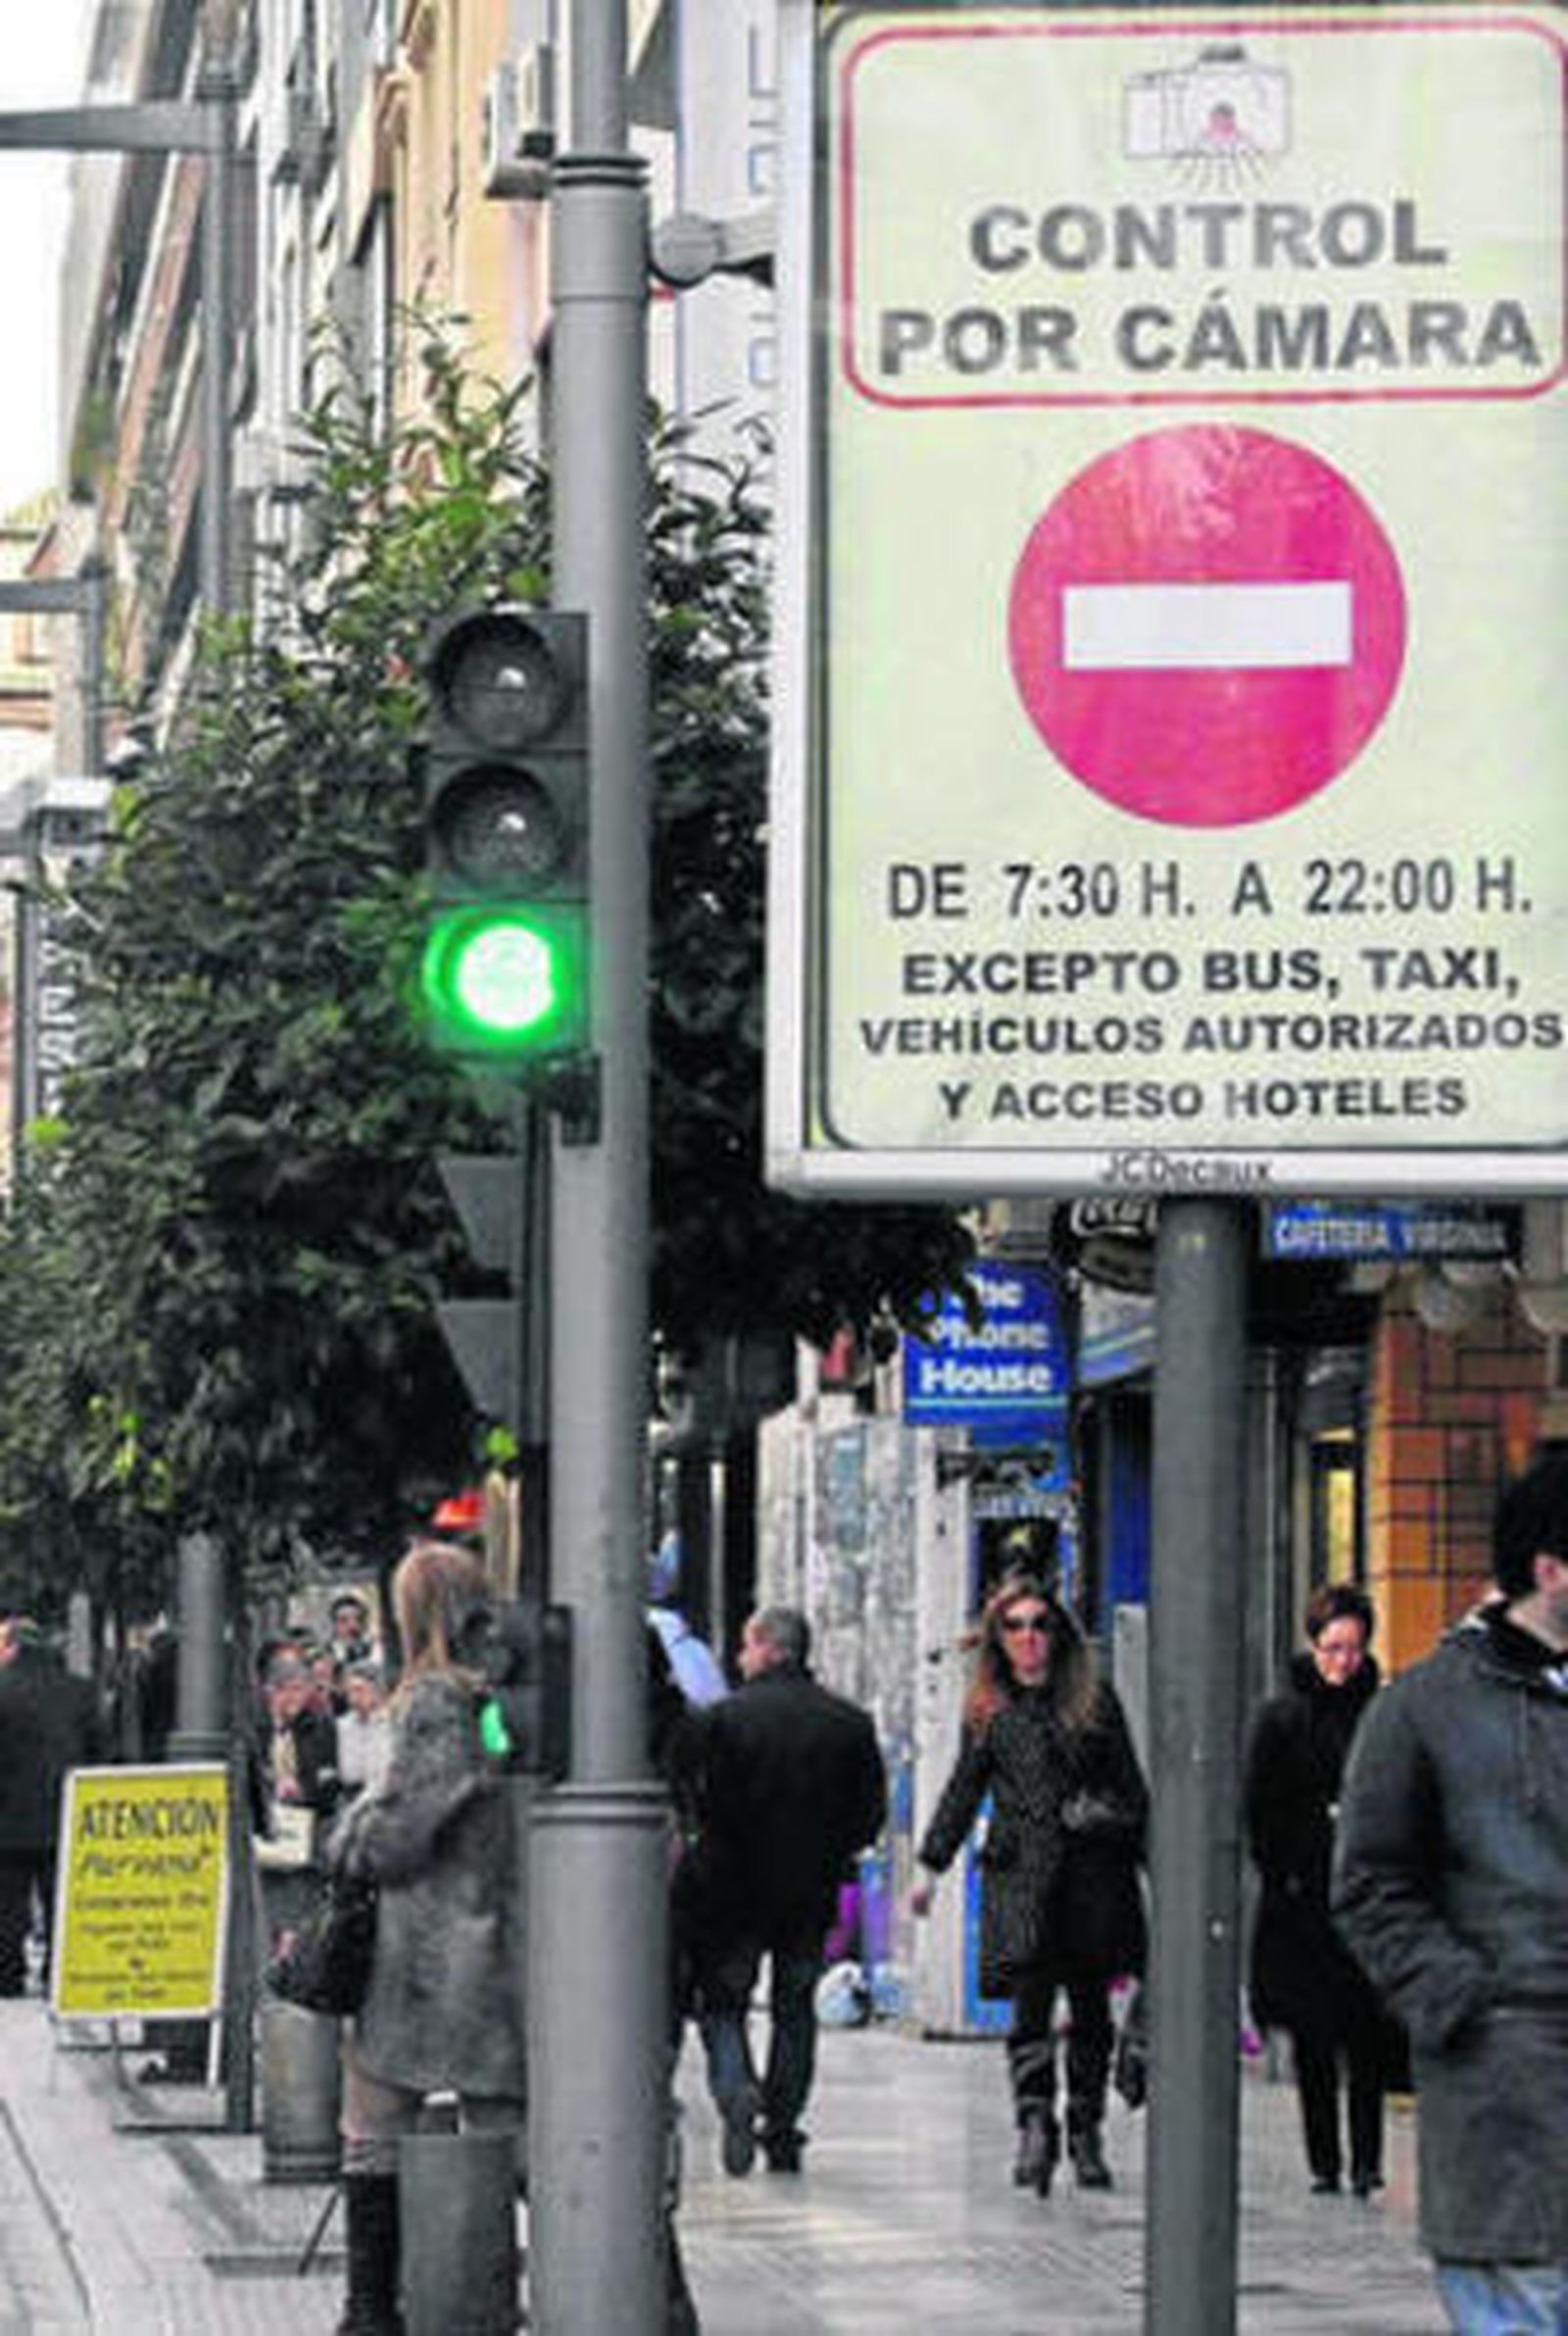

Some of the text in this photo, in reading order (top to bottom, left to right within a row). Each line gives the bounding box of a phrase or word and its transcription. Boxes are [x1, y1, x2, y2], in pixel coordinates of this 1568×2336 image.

[970, 201, 1446, 273] CONTROL
[879, 290, 1543, 375] POR CÁMARA
[889, 858, 1532, 919] DE 7:30 H. A 22:00 H.
[903, 947, 1519, 1001] EXCEPTO BUS, TAXI,
[859, 1012, 1563, 1055] VEHÍCULOS AUTORIZADOS
[938, 1078, 1467, 1120] Y ACCESO HOTELES
[919, 1358, 1052, 1394] House
